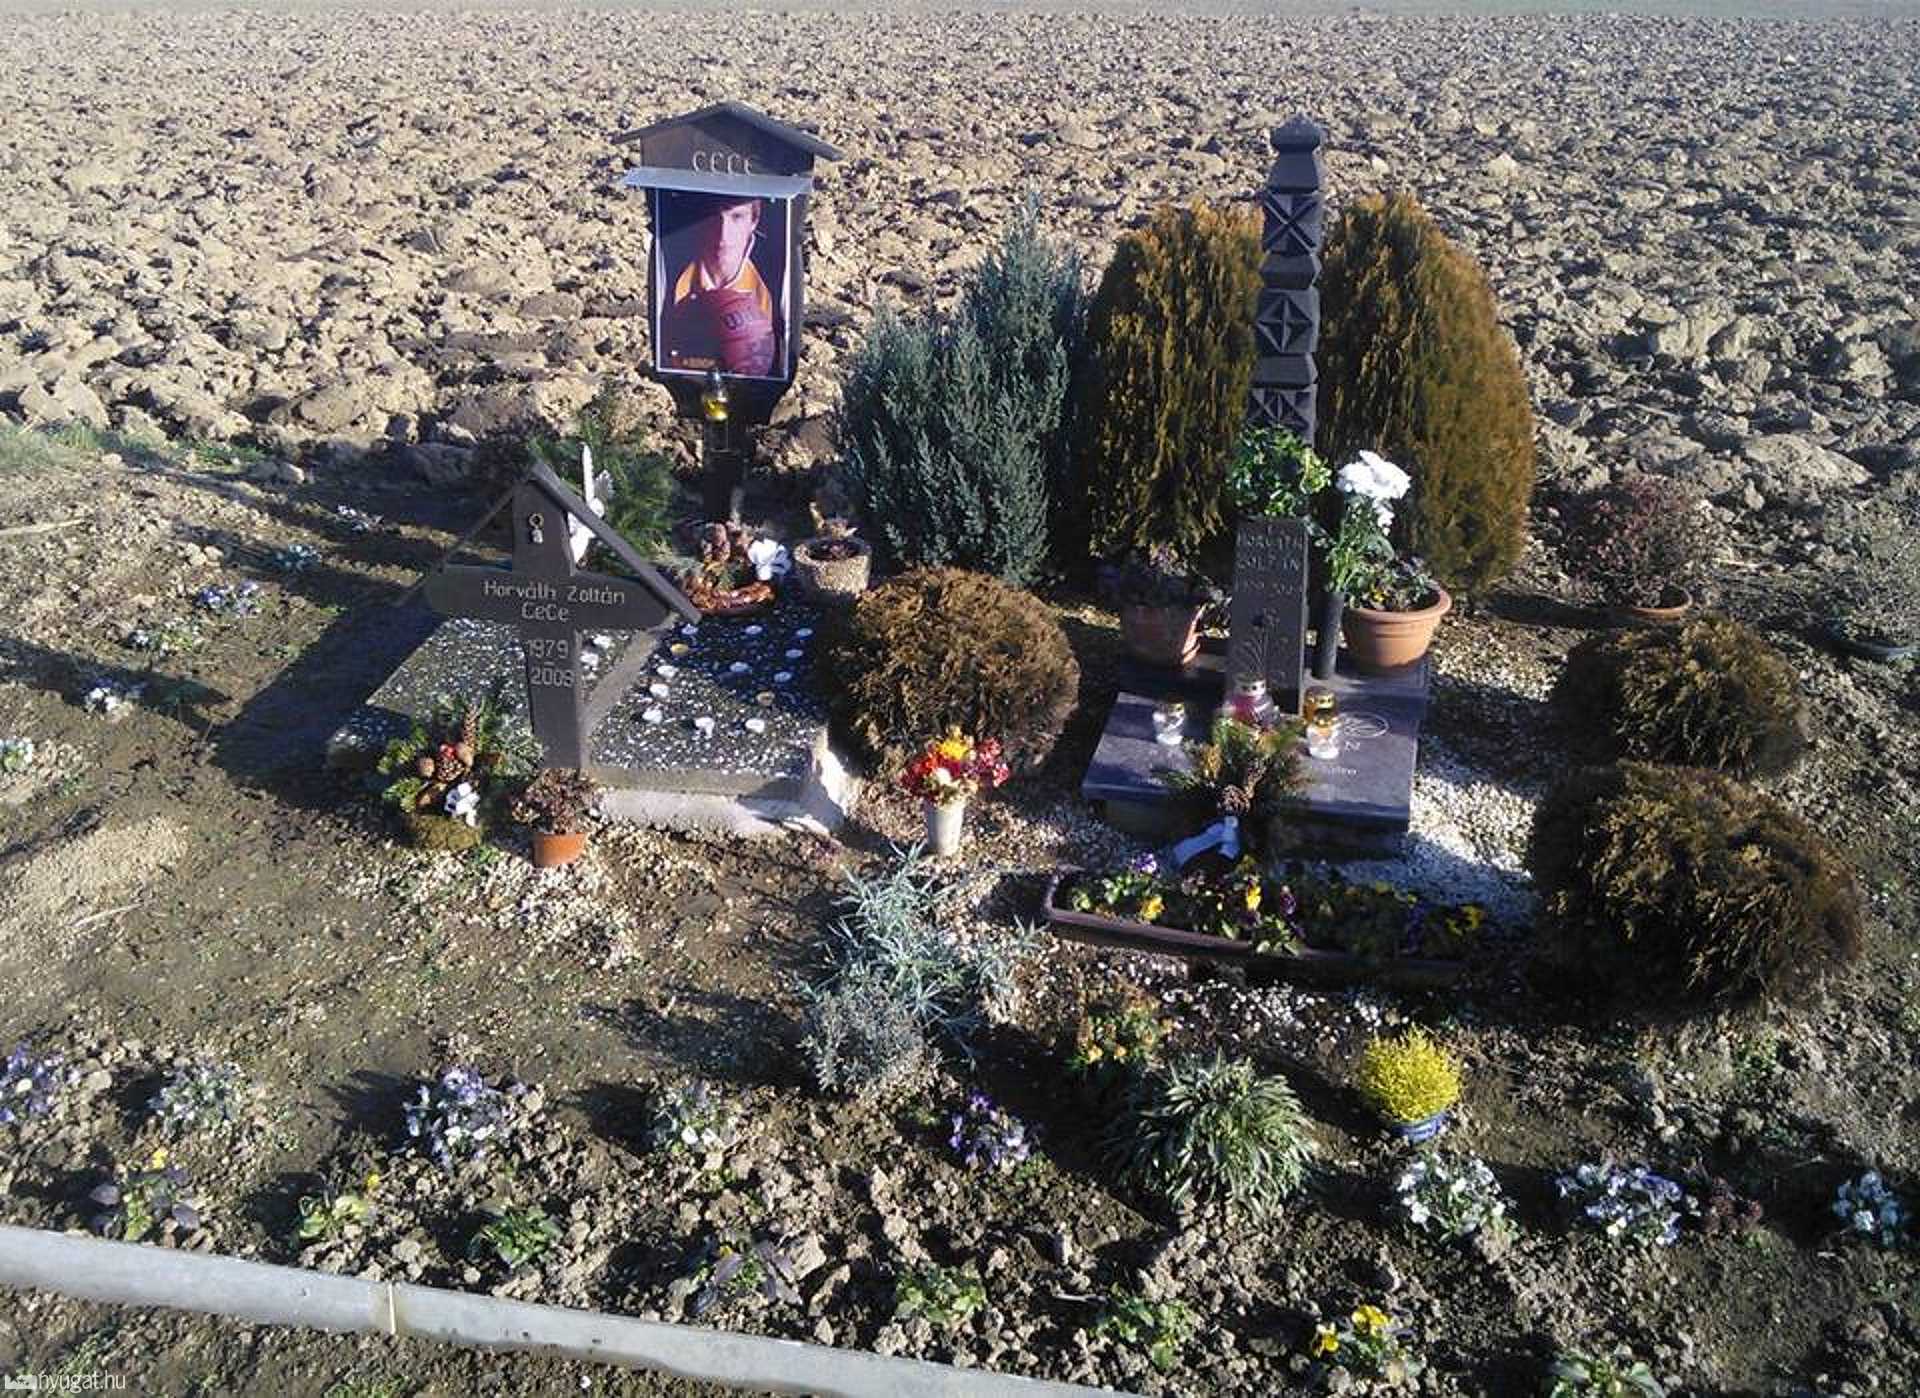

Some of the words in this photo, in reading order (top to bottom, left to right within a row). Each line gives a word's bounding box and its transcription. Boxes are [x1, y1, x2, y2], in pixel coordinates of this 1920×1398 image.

[483, 580, 557, 600] Horváth
[565, 585, 625, 605] Zoltán
[526, 639, 569, 659] 1979
